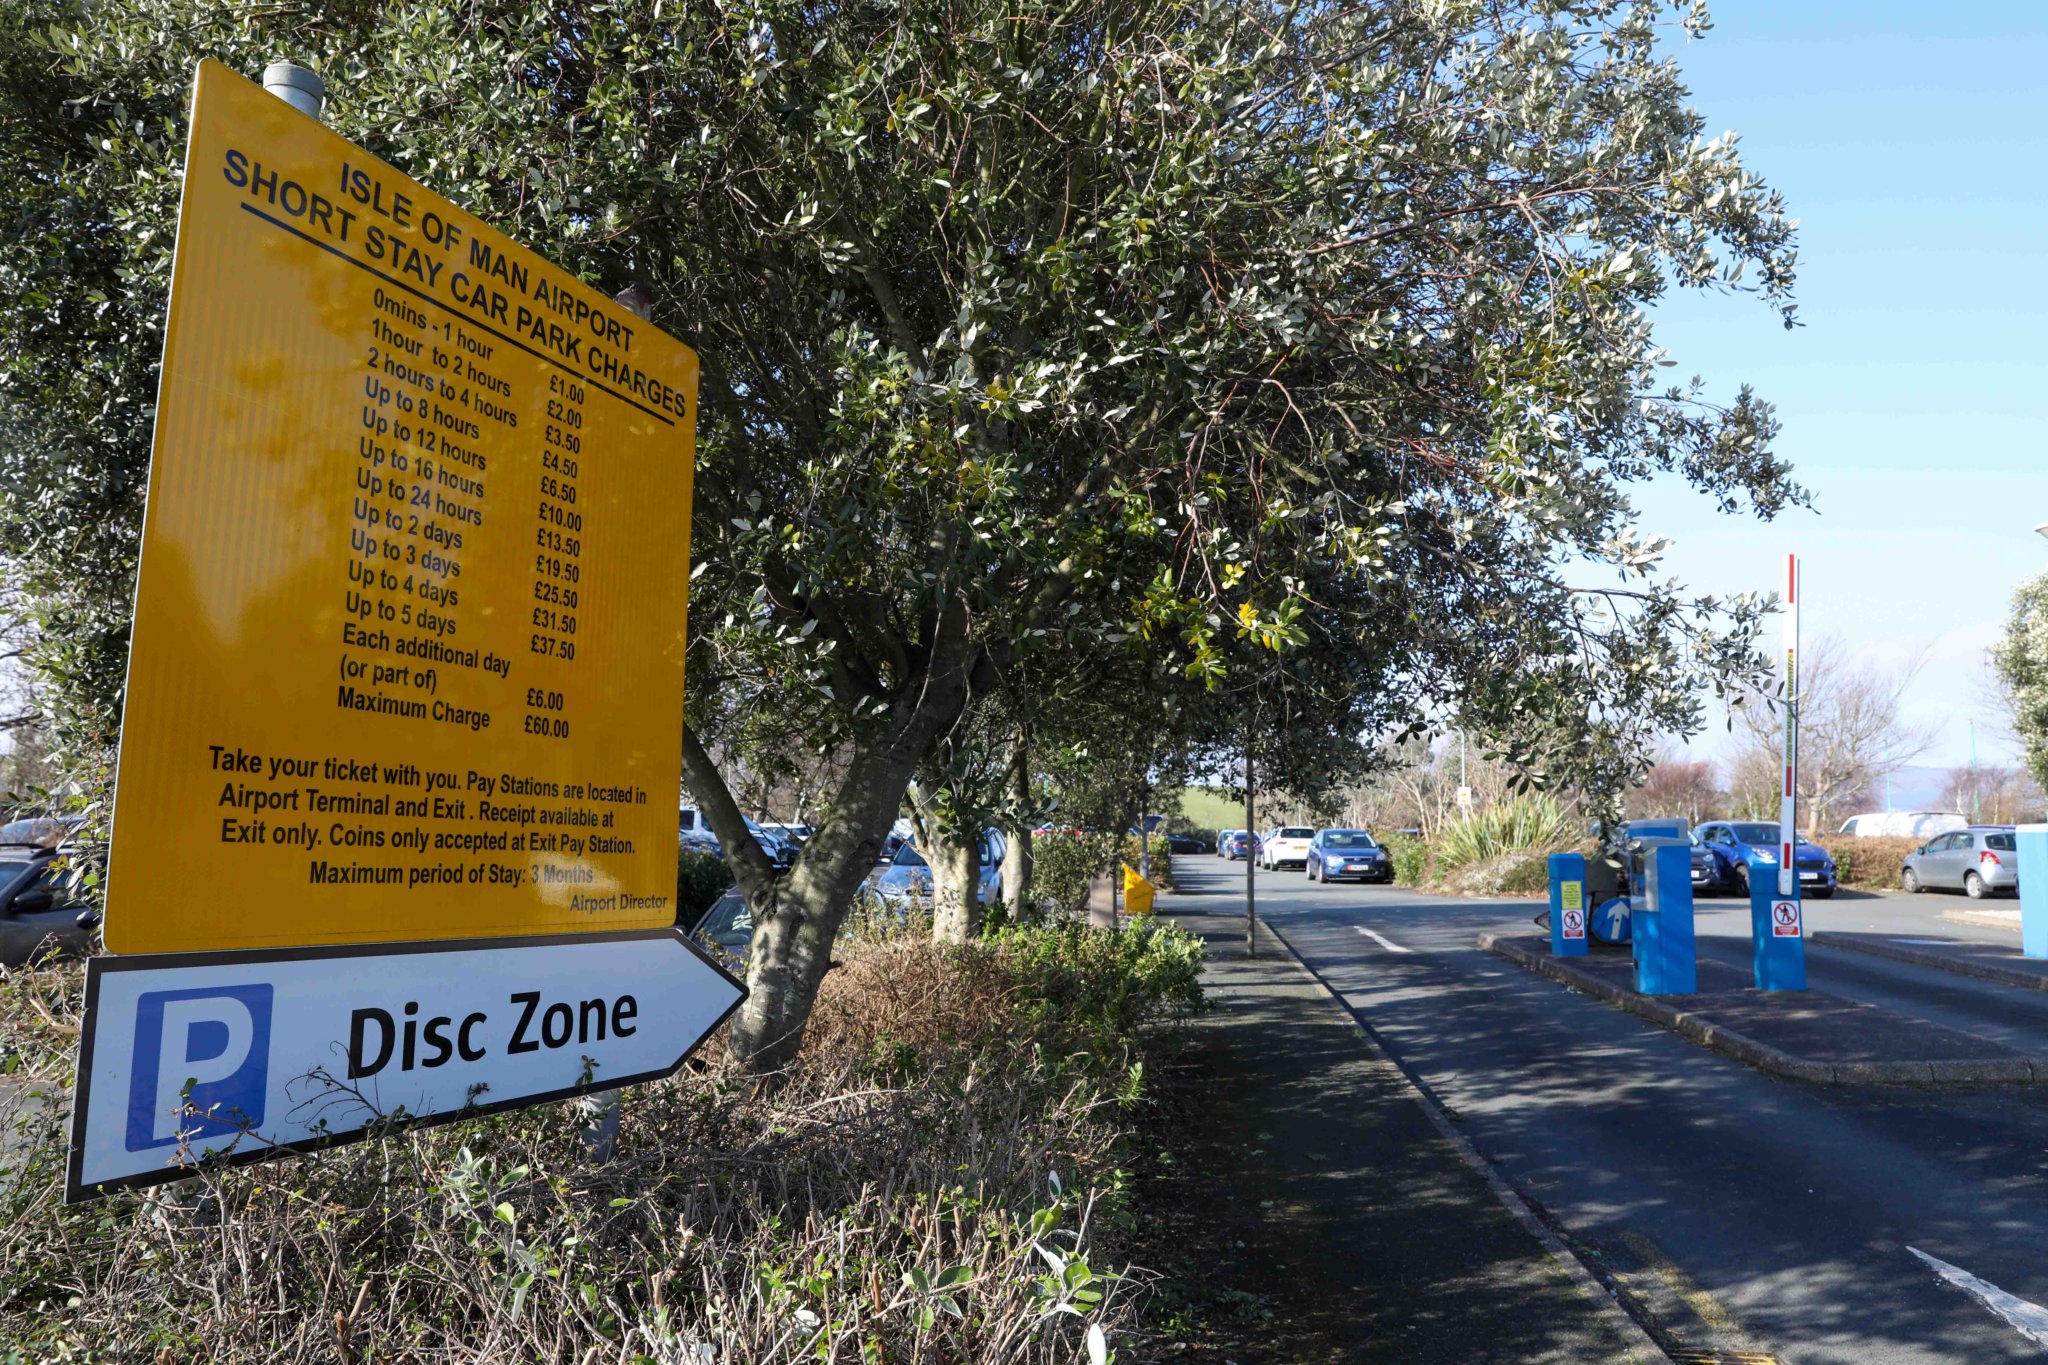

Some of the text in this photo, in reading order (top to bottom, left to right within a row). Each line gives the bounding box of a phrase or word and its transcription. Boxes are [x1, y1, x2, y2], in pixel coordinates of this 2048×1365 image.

[223, 149, 686, 417] SHORT STAY CAR PARK CHARGES
[341, 163, 634, 351] ISLE OF MAN AIRPORT
[374, 288, 426, 330] 0mins
[444, 322, 450, 340] 1
[458, 328, 493, 360] hour
[550, 375, 584, 405] £1.00
[366, 376, 577, 479] Up to 8 hours £4.50
[368, 347, 580, 454] 2 hours to 4 hours £3.50
[433, 347, 448, 368] to
[453, 356, 463, 375] 2
[468, 362, 511, 397] hours
[547, 400, 581, 429] £2.00
[360, 437, 581, 532] Up to 16 hours £10.00
[363, 406, 576, 504] Up to 12 hours £6.50
[355, 497, 579, 583] Up to 2 days £19.50
[357, 467, 580, 557] Up to 24 hours £13.50
[349, 560, 576, 634] Up to 4 days £31.50
[352, 528, 577, 609] Up to 3 days £25.50
[343, 622, 510, 679] Each additional day
[346, 591, 574, 660] Up to 5 days £37.50
[338, 686, 569, 738] Maximum Charge £60.00
[340, 654, 563, 711] (or part of) £6.00
[209, 745, 646, 804] Take your ticket with you. Pay Stations are located in
[218, 783, 298, 814] Airport
[306, 789, 389, 815] Terminal
[395, 798, 428, 817] and
[480, 801, 535, 827] Receipt
[540, 807, 598, 826] available
[602, 812, 614, 827] at
[222, 819, 635, 856] Exit only. Coins only accepted at Exit Pay Station.
[310, 861, 593, 888] Maximum period of Stay: 3 Months
[570, 894, 667, 914] Airport Director
[153, 997, 253, 1141] P
[347, 991, 639, 1080] Disc Zone
